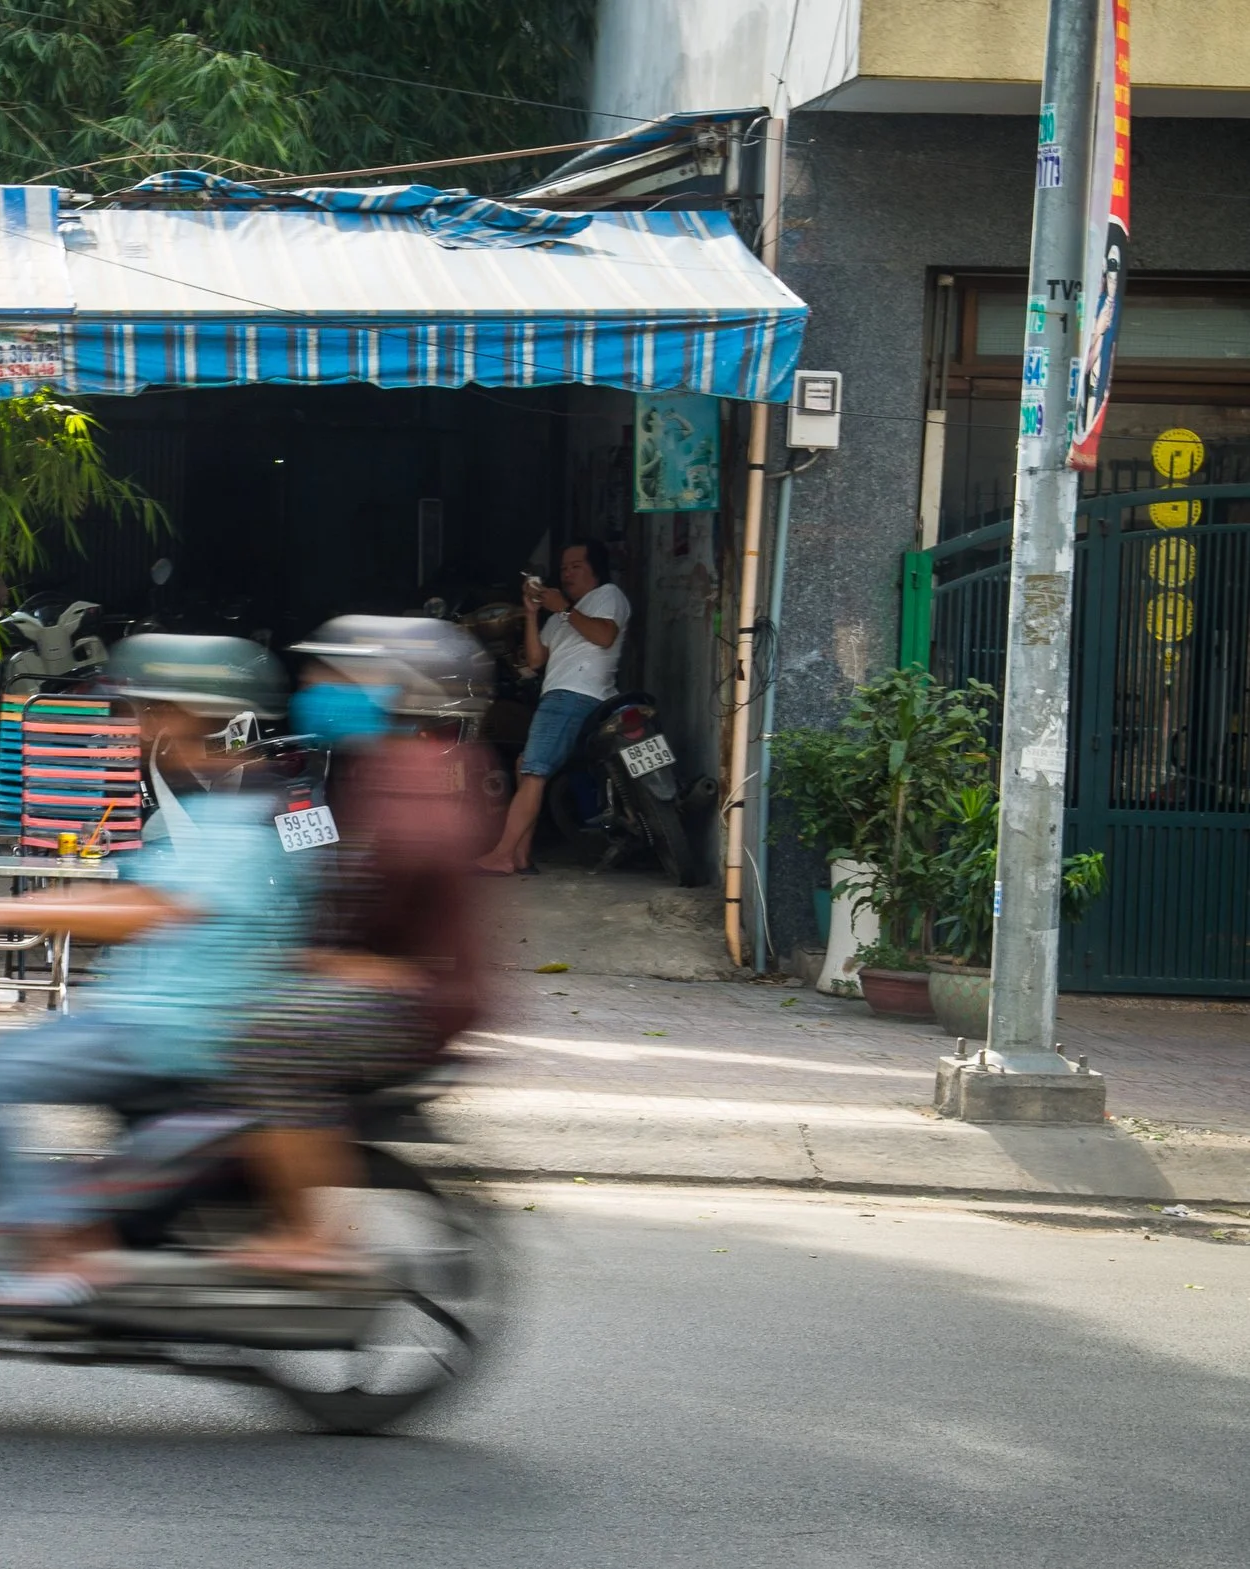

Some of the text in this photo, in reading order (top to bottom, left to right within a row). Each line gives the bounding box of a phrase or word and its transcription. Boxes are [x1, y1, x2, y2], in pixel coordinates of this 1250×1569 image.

[629, 750, 671, 774] 013.99
[284, 811, 322, 832] 59-C1
[285, 826, 334, 849] 335.33
